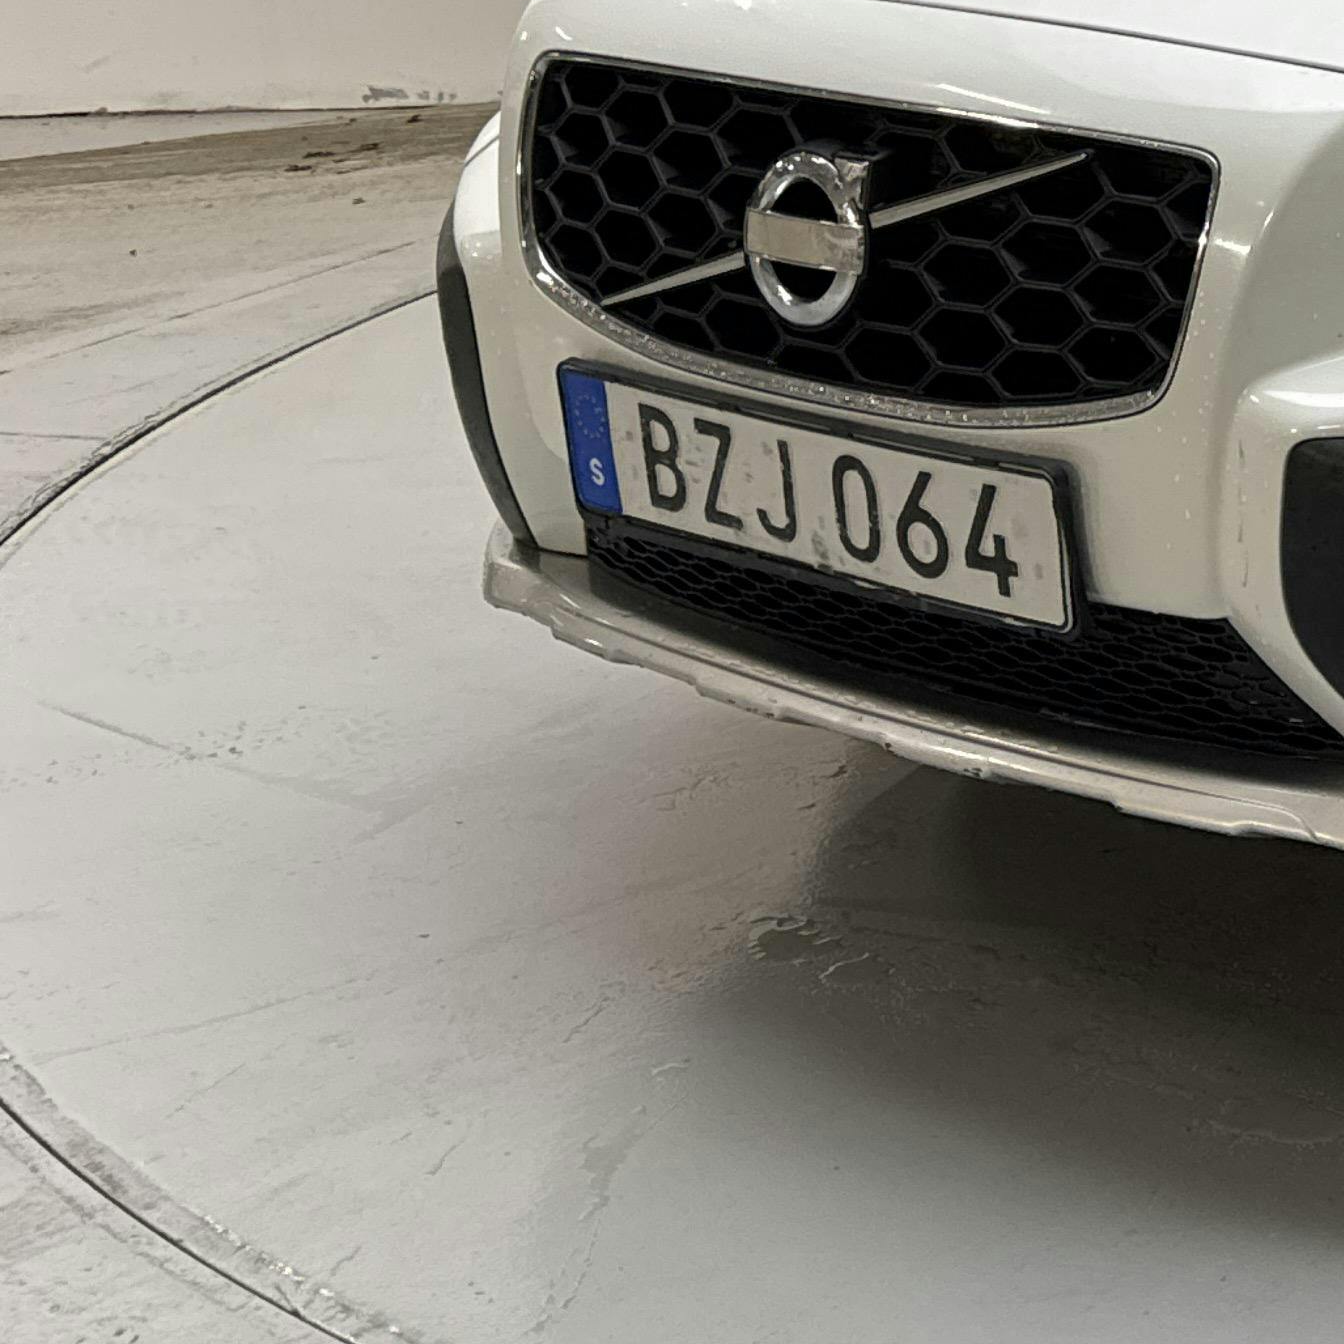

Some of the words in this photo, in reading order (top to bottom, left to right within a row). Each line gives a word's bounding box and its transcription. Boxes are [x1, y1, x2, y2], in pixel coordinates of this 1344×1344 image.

[590, 457, 605, 486] S
[637, 402, 798, 543] BZJ
[831, 454, 1019, 598] 064
